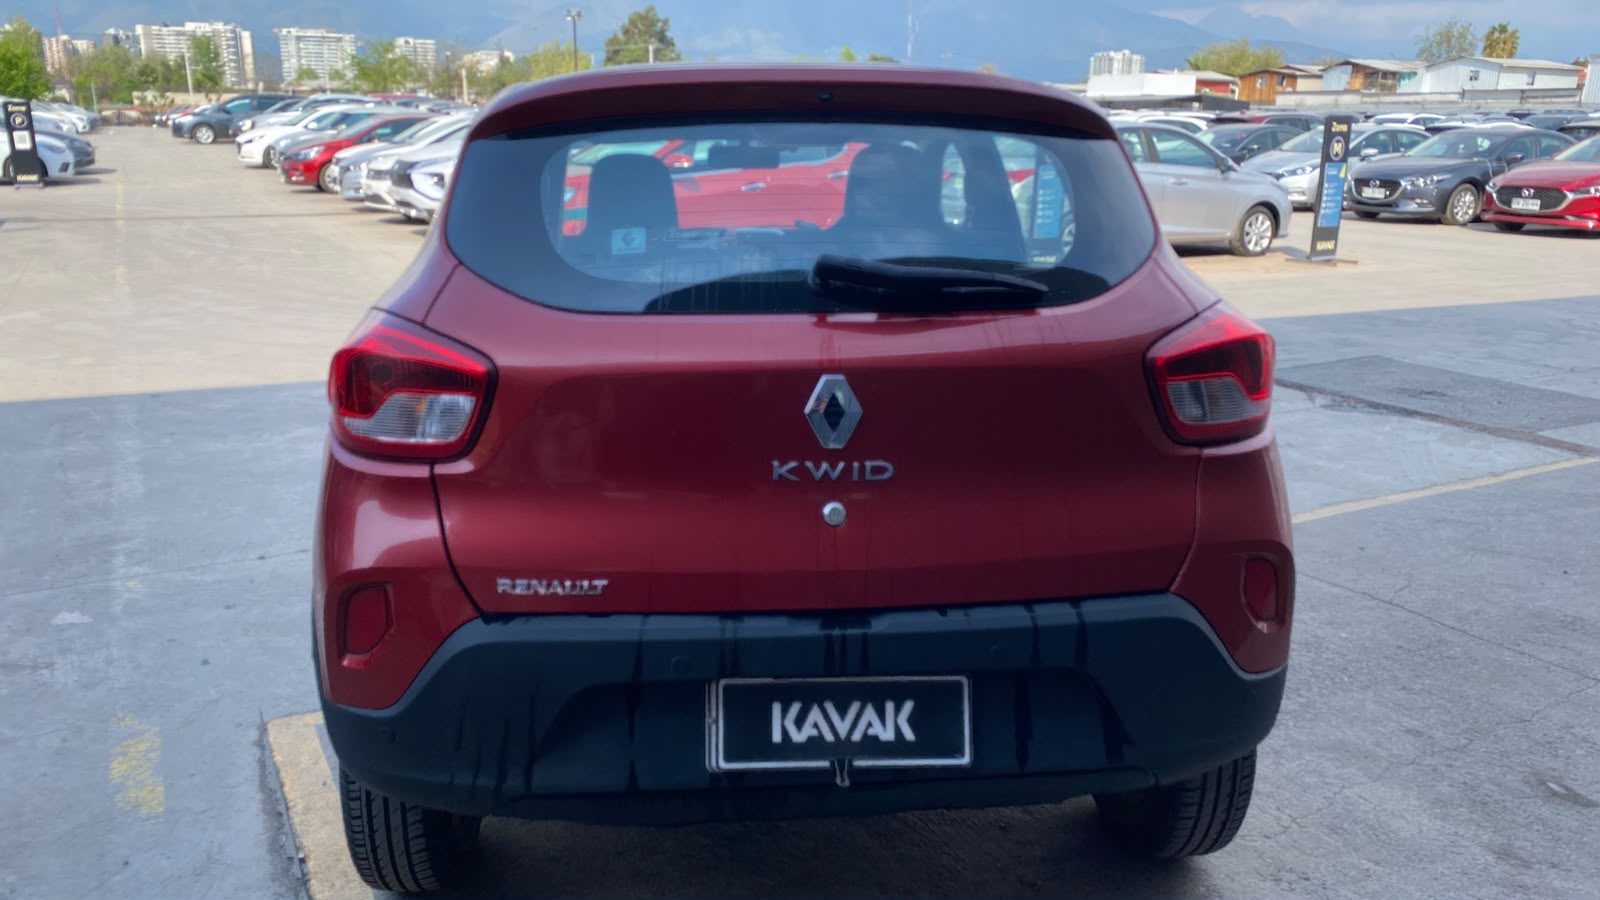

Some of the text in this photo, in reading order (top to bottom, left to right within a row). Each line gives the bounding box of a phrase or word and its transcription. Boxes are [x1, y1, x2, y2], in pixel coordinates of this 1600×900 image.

[1331, 121, 1348, 132] Zona
[1333, 142, 1342, 154] M
[771, 459, 895, 481] KWID
[496, 578, 609, 596] RENAULT
[771, 699, 916, 744] KAVAK
